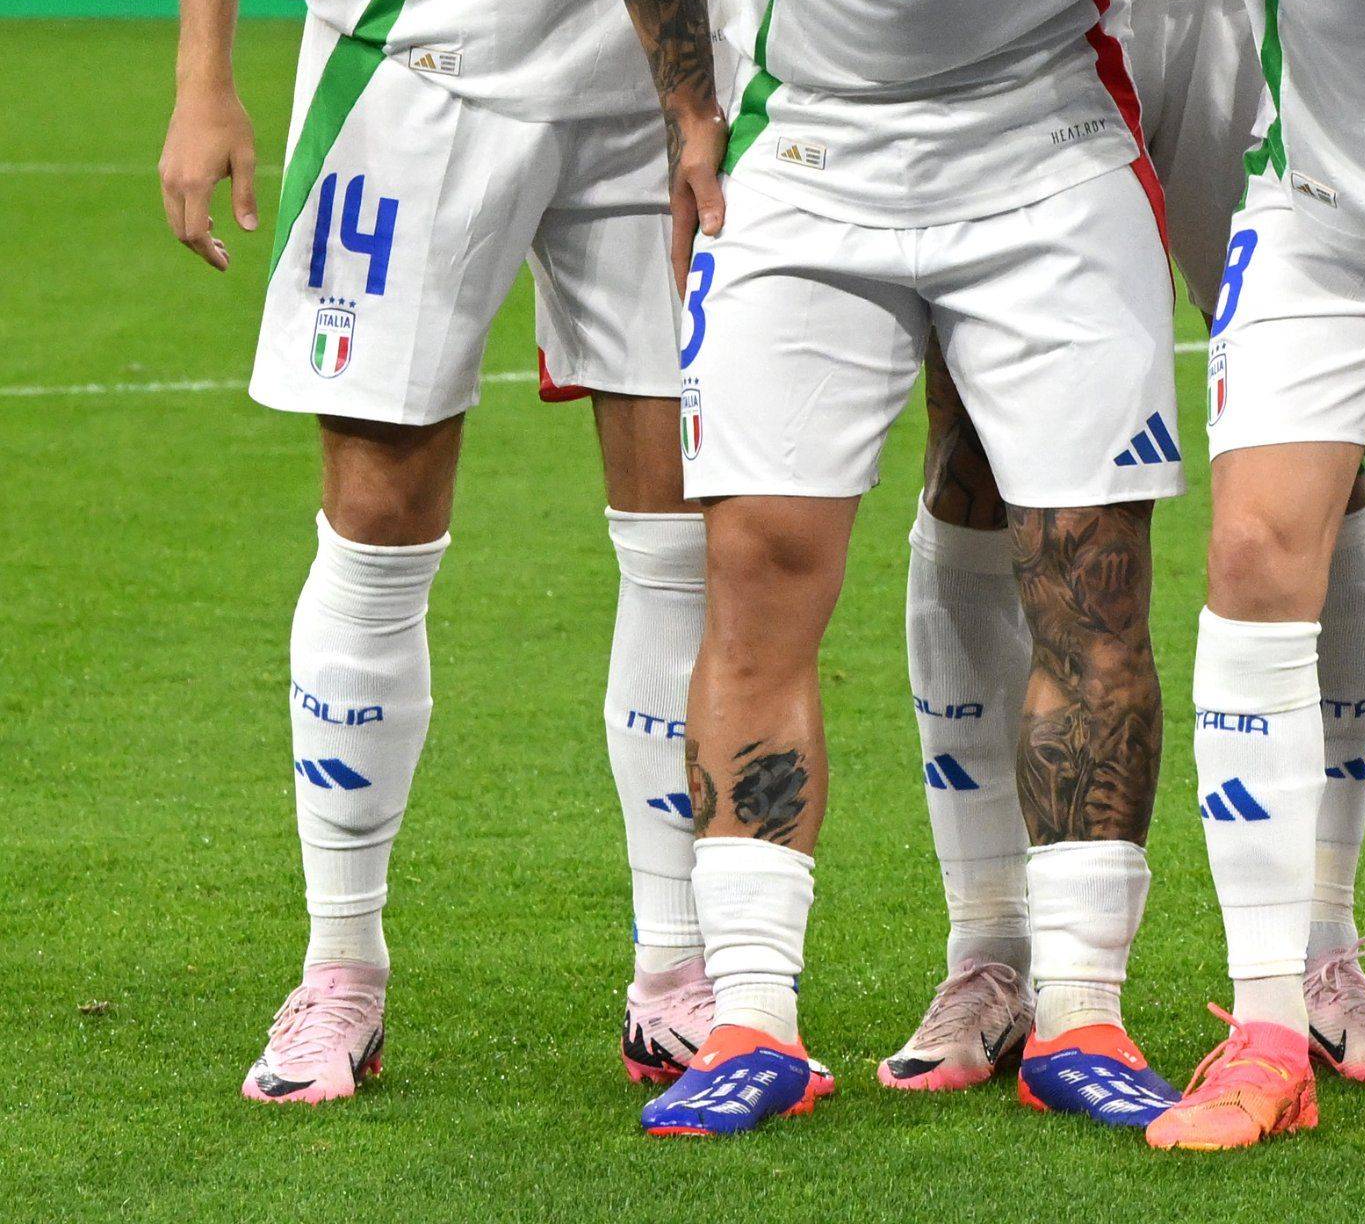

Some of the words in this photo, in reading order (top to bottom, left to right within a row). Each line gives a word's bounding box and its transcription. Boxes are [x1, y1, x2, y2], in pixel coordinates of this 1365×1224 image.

[308, 172, 400, 296] 14
[319, 314, 351, 329] ITALIA
[680, 251, 716, 371] 3
